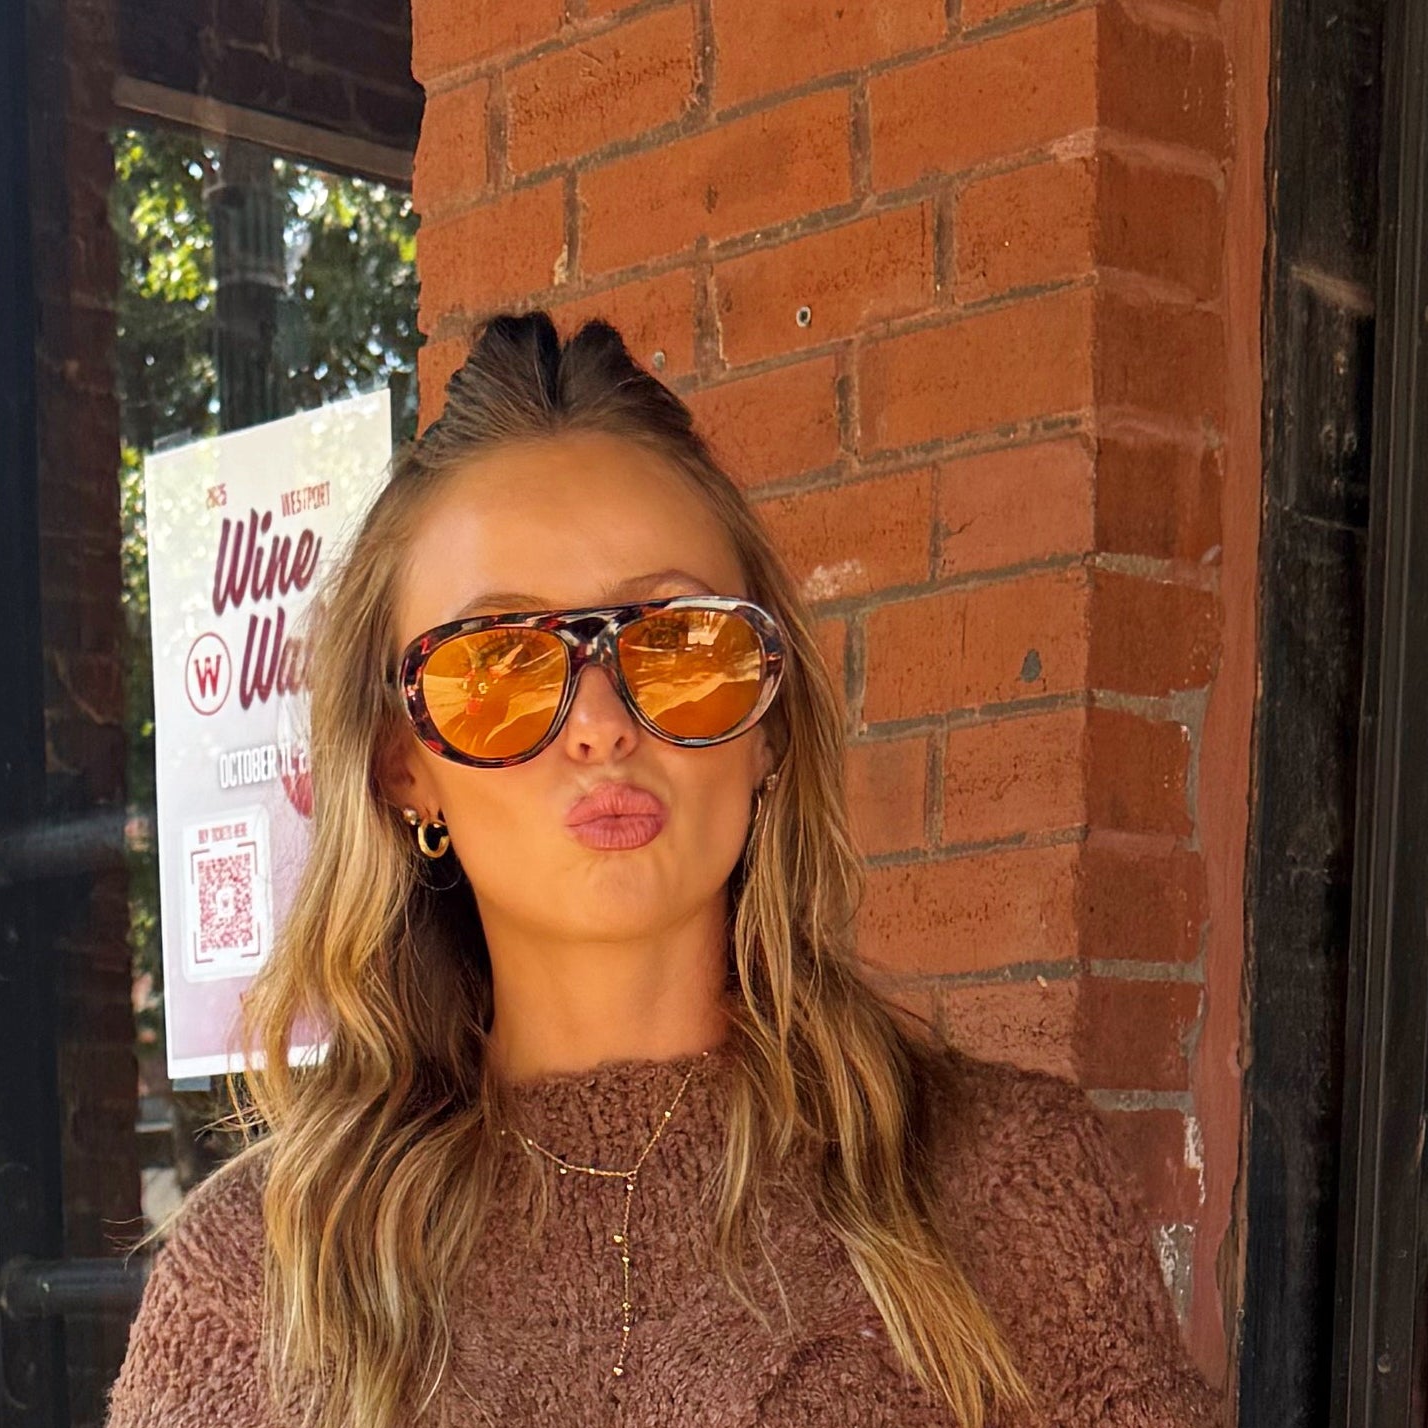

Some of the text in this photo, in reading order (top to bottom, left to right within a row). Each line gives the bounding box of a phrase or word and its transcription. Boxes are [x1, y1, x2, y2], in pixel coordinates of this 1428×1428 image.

[281, 481, 331, 517] WESTPORT
[213, 508, 322, 616] Wine
[220, 745, 277, 788] OCTOBER
